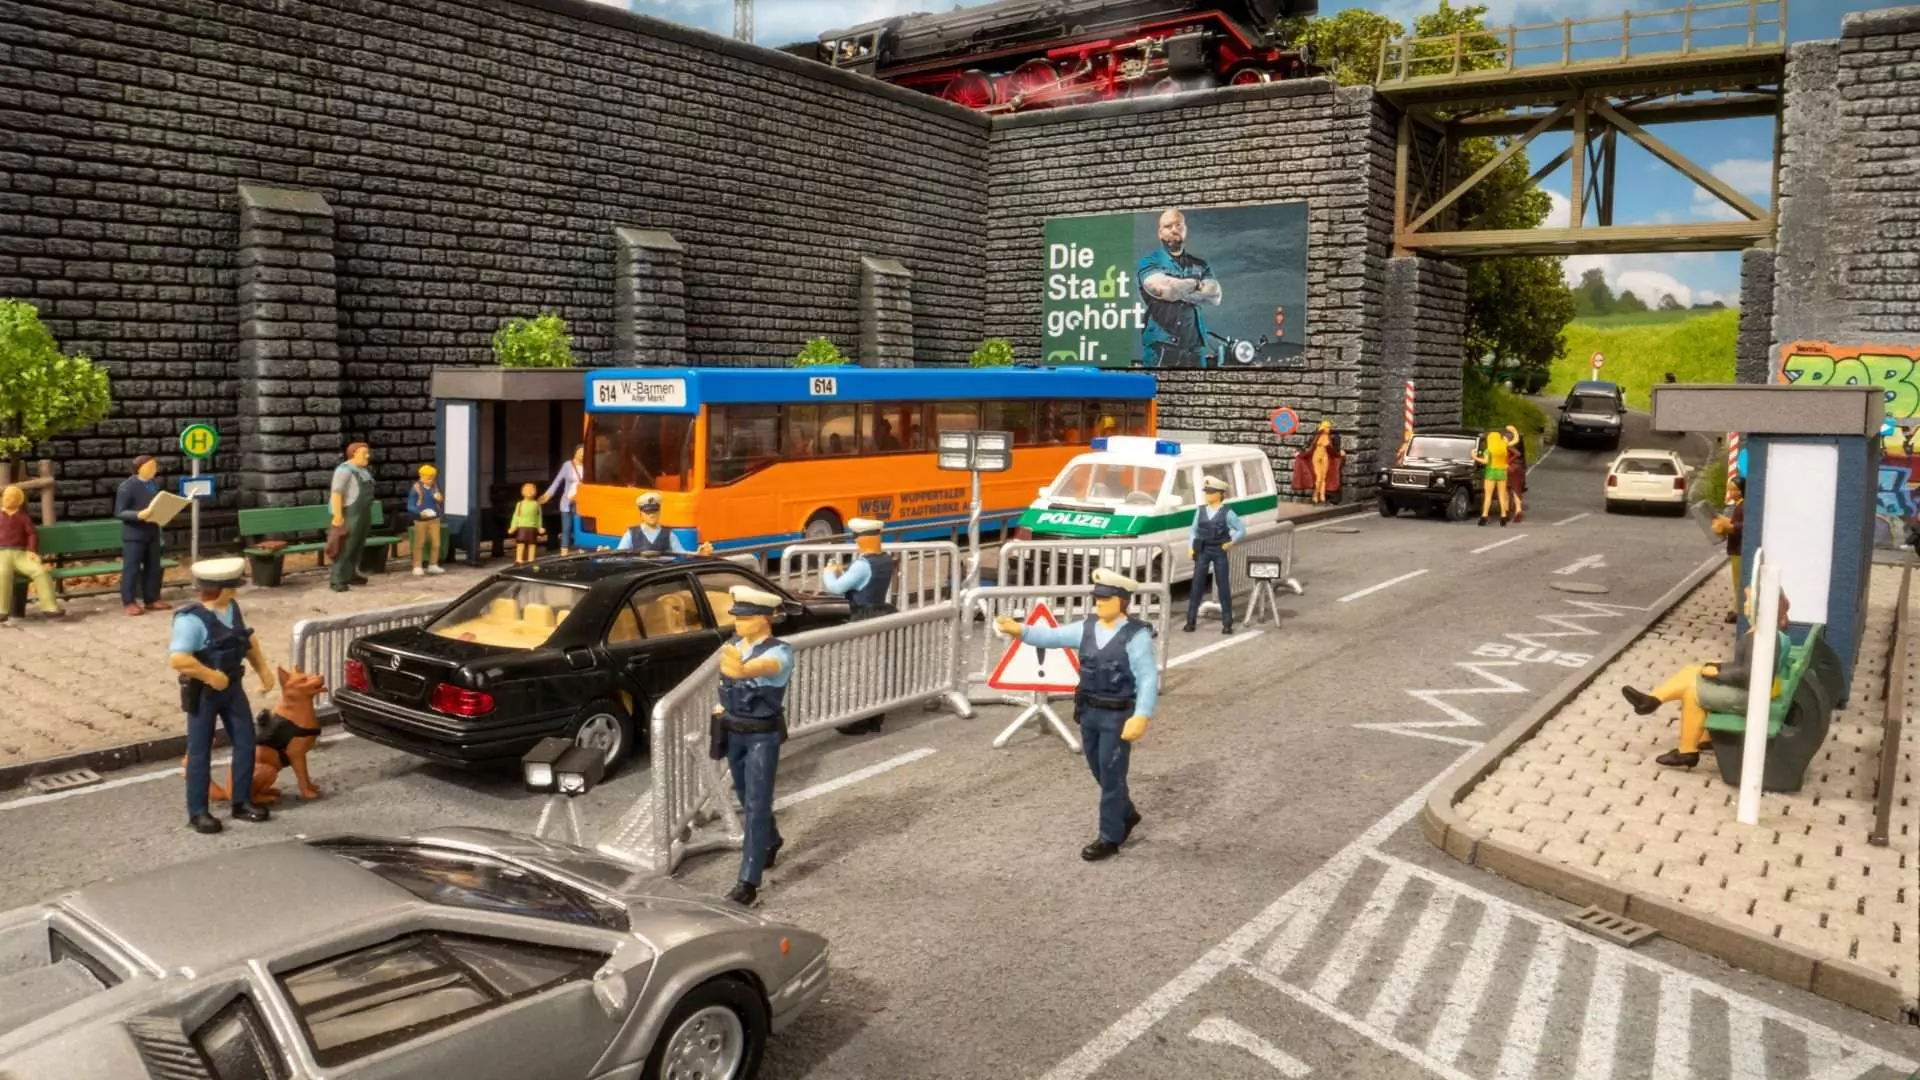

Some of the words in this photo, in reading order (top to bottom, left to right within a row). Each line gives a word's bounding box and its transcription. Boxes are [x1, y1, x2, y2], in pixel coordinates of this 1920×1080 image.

[1049, 242, 1095, 270] Die
[1048, 264, 1130, 300] Stadt
[1047, 302, 1146, 337] gehört
[599, 384, 617, 403] 614
[621, 381, 675, 395] W.-Barmen
[814, 378, 833, 394] 614
[191, 432, 207, 449] H
[860, 498, 893, 514] WSW
[1036, 512, 1111, 530] POLIZEI
[1471, 641, 1596, 668] BUS
